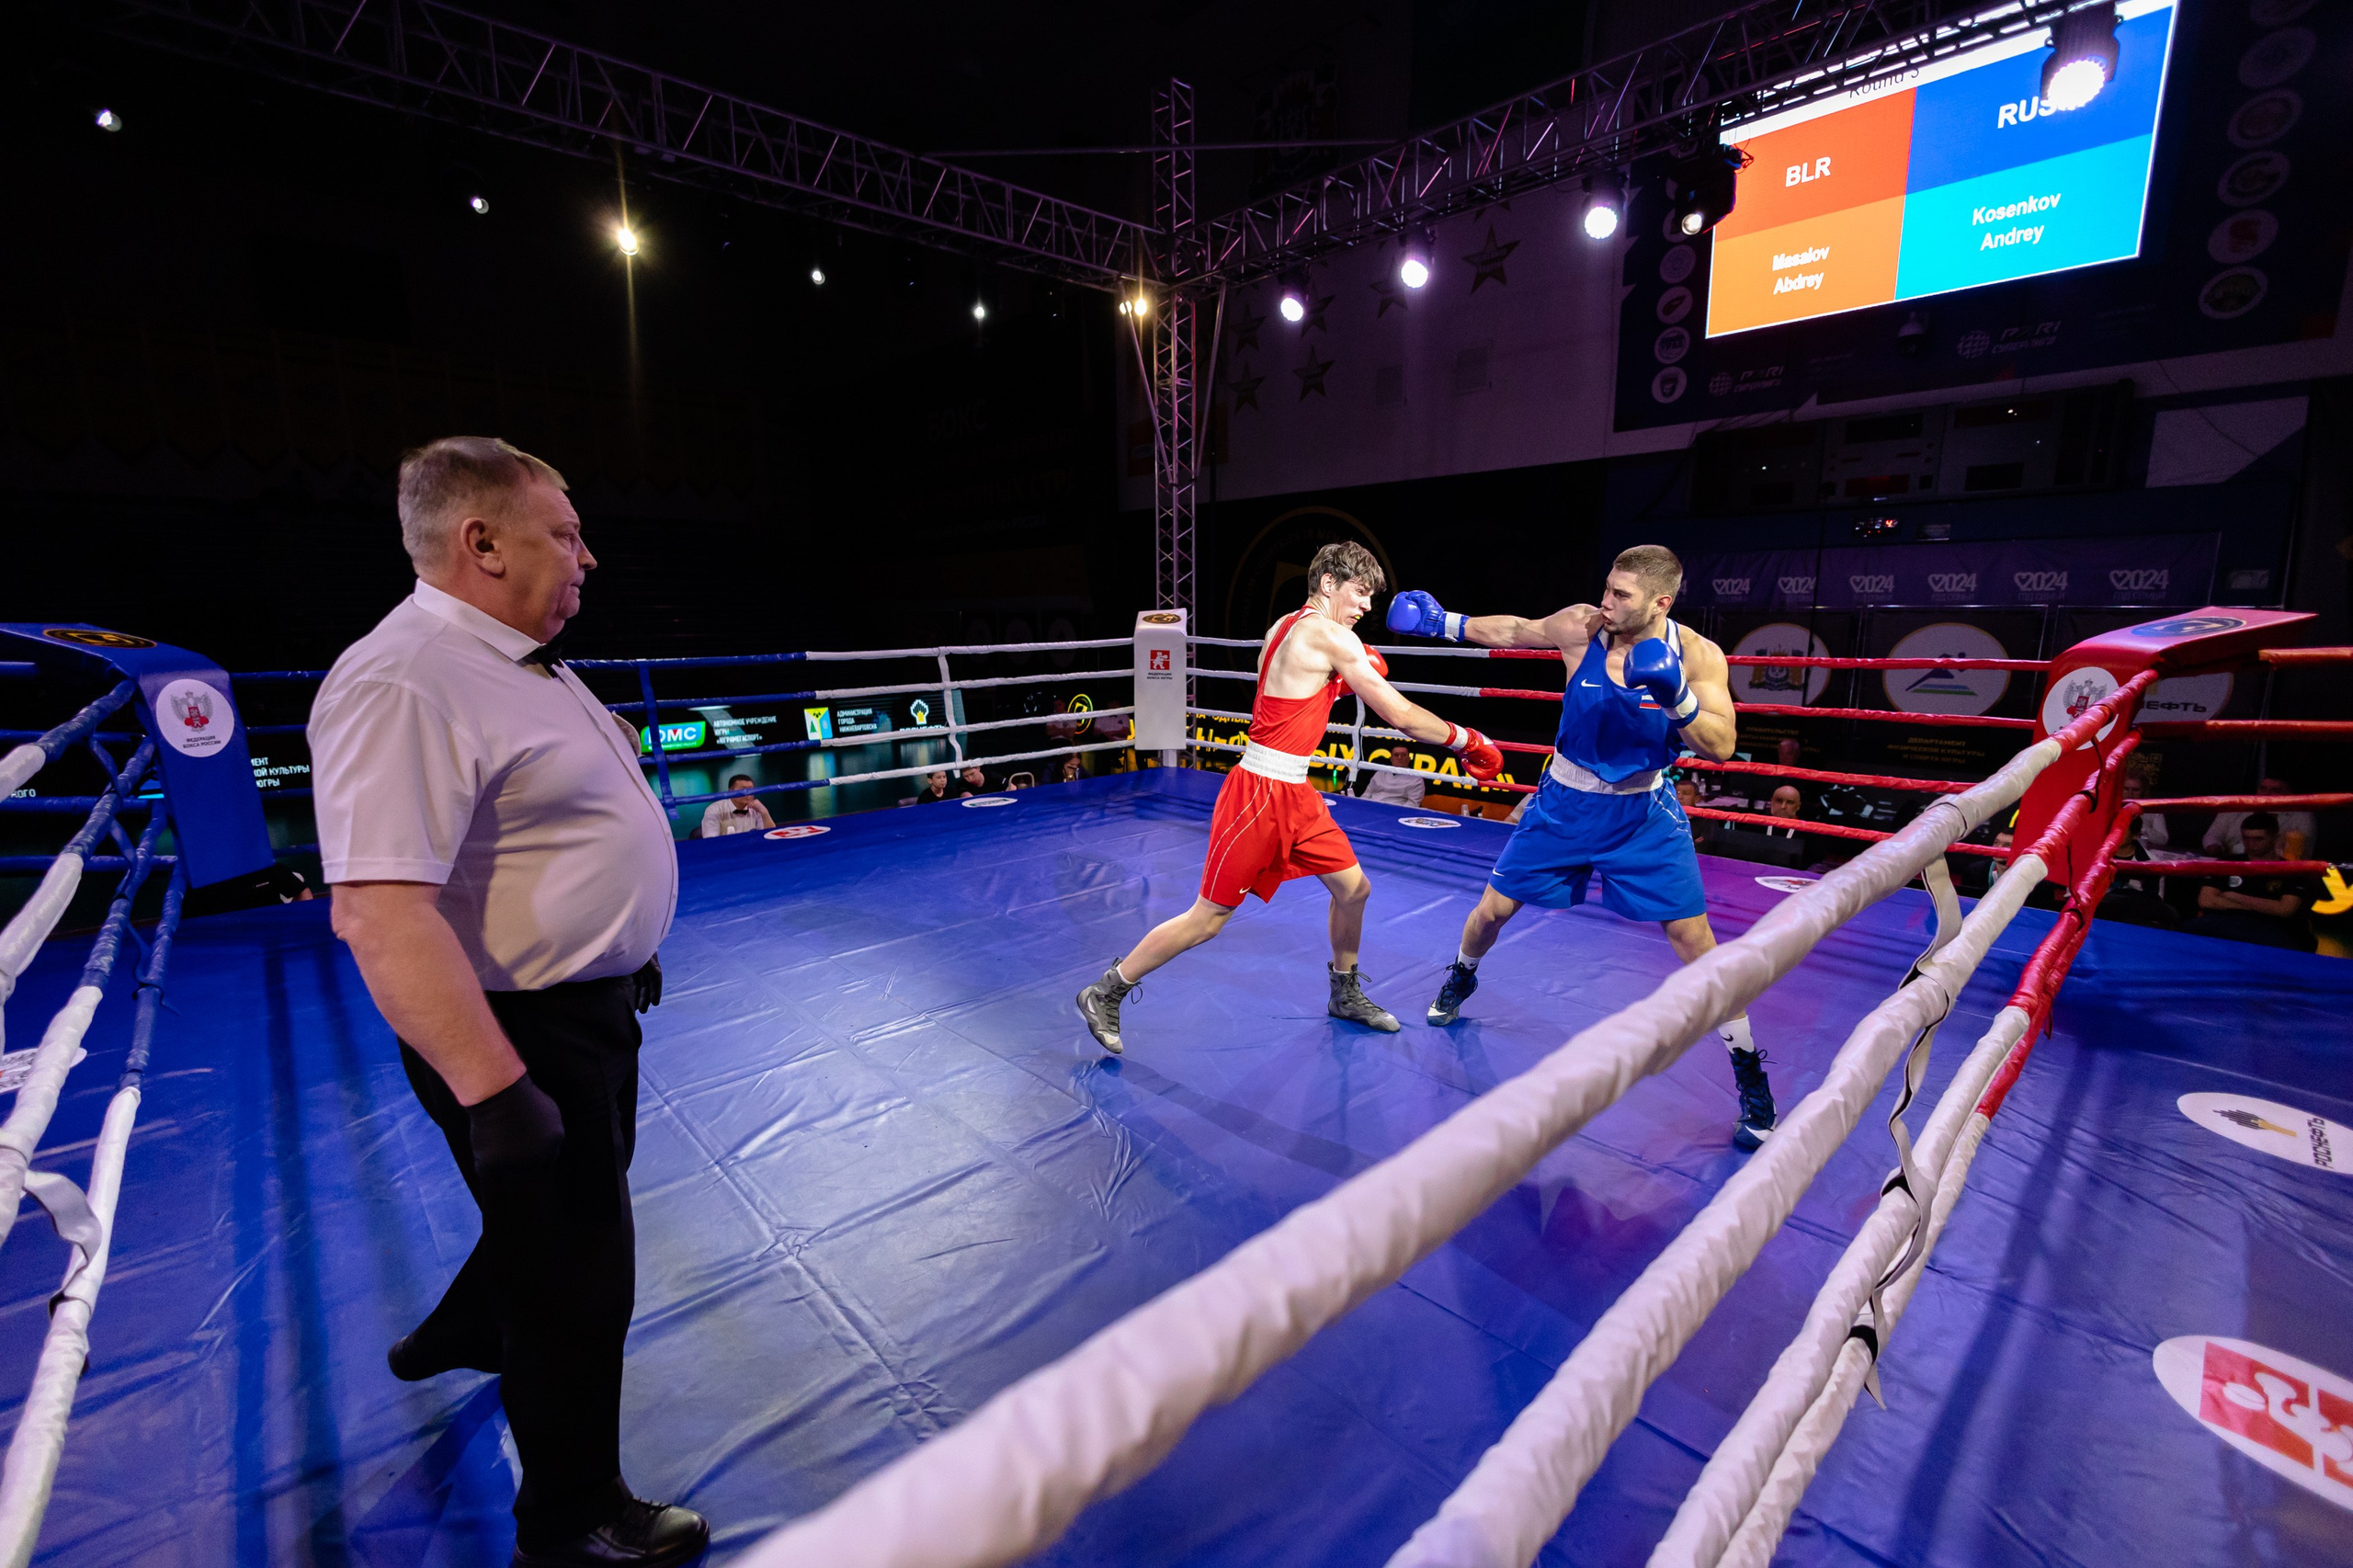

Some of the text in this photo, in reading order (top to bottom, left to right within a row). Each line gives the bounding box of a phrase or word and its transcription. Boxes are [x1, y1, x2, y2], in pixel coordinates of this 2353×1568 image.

[1785, 156, 1832, 187] BLR
[1972, 192, 2061, 226] Kosenkov
[1980, 223, 2045, 251] Andrey
[268, 765, 310, 776] КУЛЬТУРЫ
[2307, 1118, 2335, 1168] РОСНЕФТЬ
